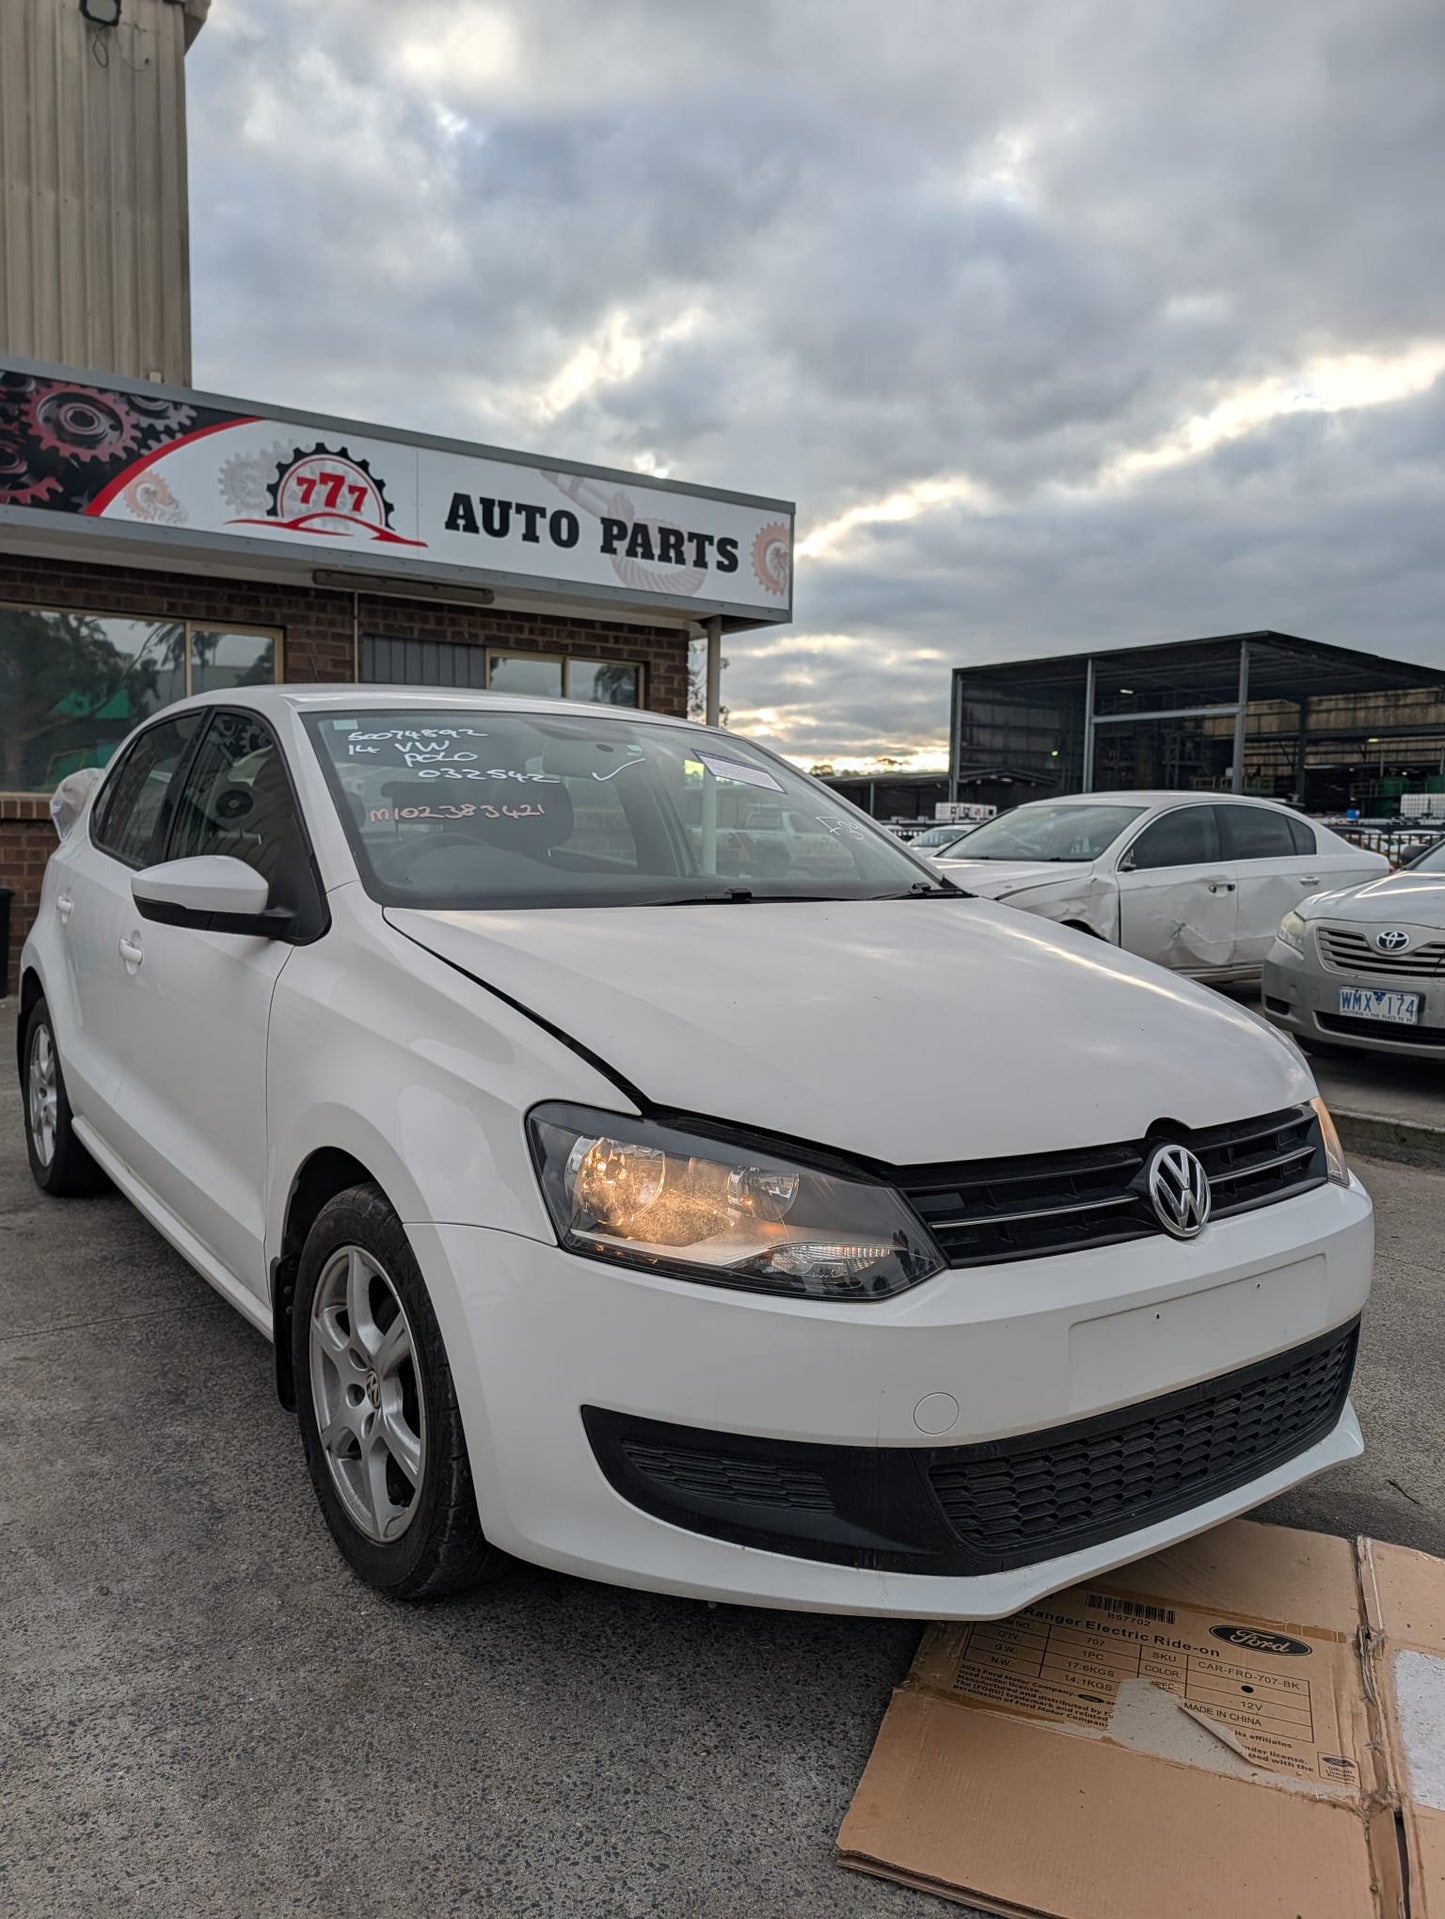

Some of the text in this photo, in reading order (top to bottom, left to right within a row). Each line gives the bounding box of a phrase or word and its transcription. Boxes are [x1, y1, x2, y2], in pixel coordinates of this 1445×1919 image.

[295, 472, 368, 512] 777
[444, 492, 739, 574] AUTO PARTS
[395, 740, 449, 753] VW
[404, 752, 478, 767] POLO
[418, 768, 561, 783] 032542
[1342, 992, 1414, 1018] WMX 174
[1024, 1607, 1081, 1627] Ranger
[1085, 1622, 1149, 1642] Electric
[1153, 1635, 1220, 1657] Ride-on
[1086, 1637, 1105, 1647] 707
[1229, 1629, 1290, 1653] Ford
[1083, 1650, 1104, 1661] 1PC
[1152, 1652, 1176, 1663] SKU
[1145, 1664, 1181, 1679] COLOR:
[1198, 1661, 1300, 1690] CAR-FRD-707-BK
[982, 1674, 1007, 1685] under
[1004, 1674, 1030, 1685] Motor
[1032, 1681, 1076, 1697] Company.
[952, 1684, 1002, 1701] permission
[1004, 1696, 1013, 1704] of
[1015, 1699, 1035, 1710] Ford
[1037, 1705, 1065, 1718] Motor
[955, 1679, 972, 1688] The
[1006, 1690, 1054, 1708] trademark
[1055, 1703, 1073, 1713] and
[1075, 1706, 1108, 1722] related
[957, 1674, 1018, 1694] Manufactured
[1019, 1688, 1036, 1698] and
[1038, 1692, 1089, 1711] distributed
[1090, 1706, 1104, 1715] by
[1240, 1701, 1263, 1711] 12V
[1184, 1702, 1262, 1727] MADE IN CHINA
[1249, 1734, 1293, 1749] affiliates
[1269, 1751, 1307, 1765] license.
[1271, 1758, 1295, 1768] with
[1297, 1764, 1314, 1772] the
